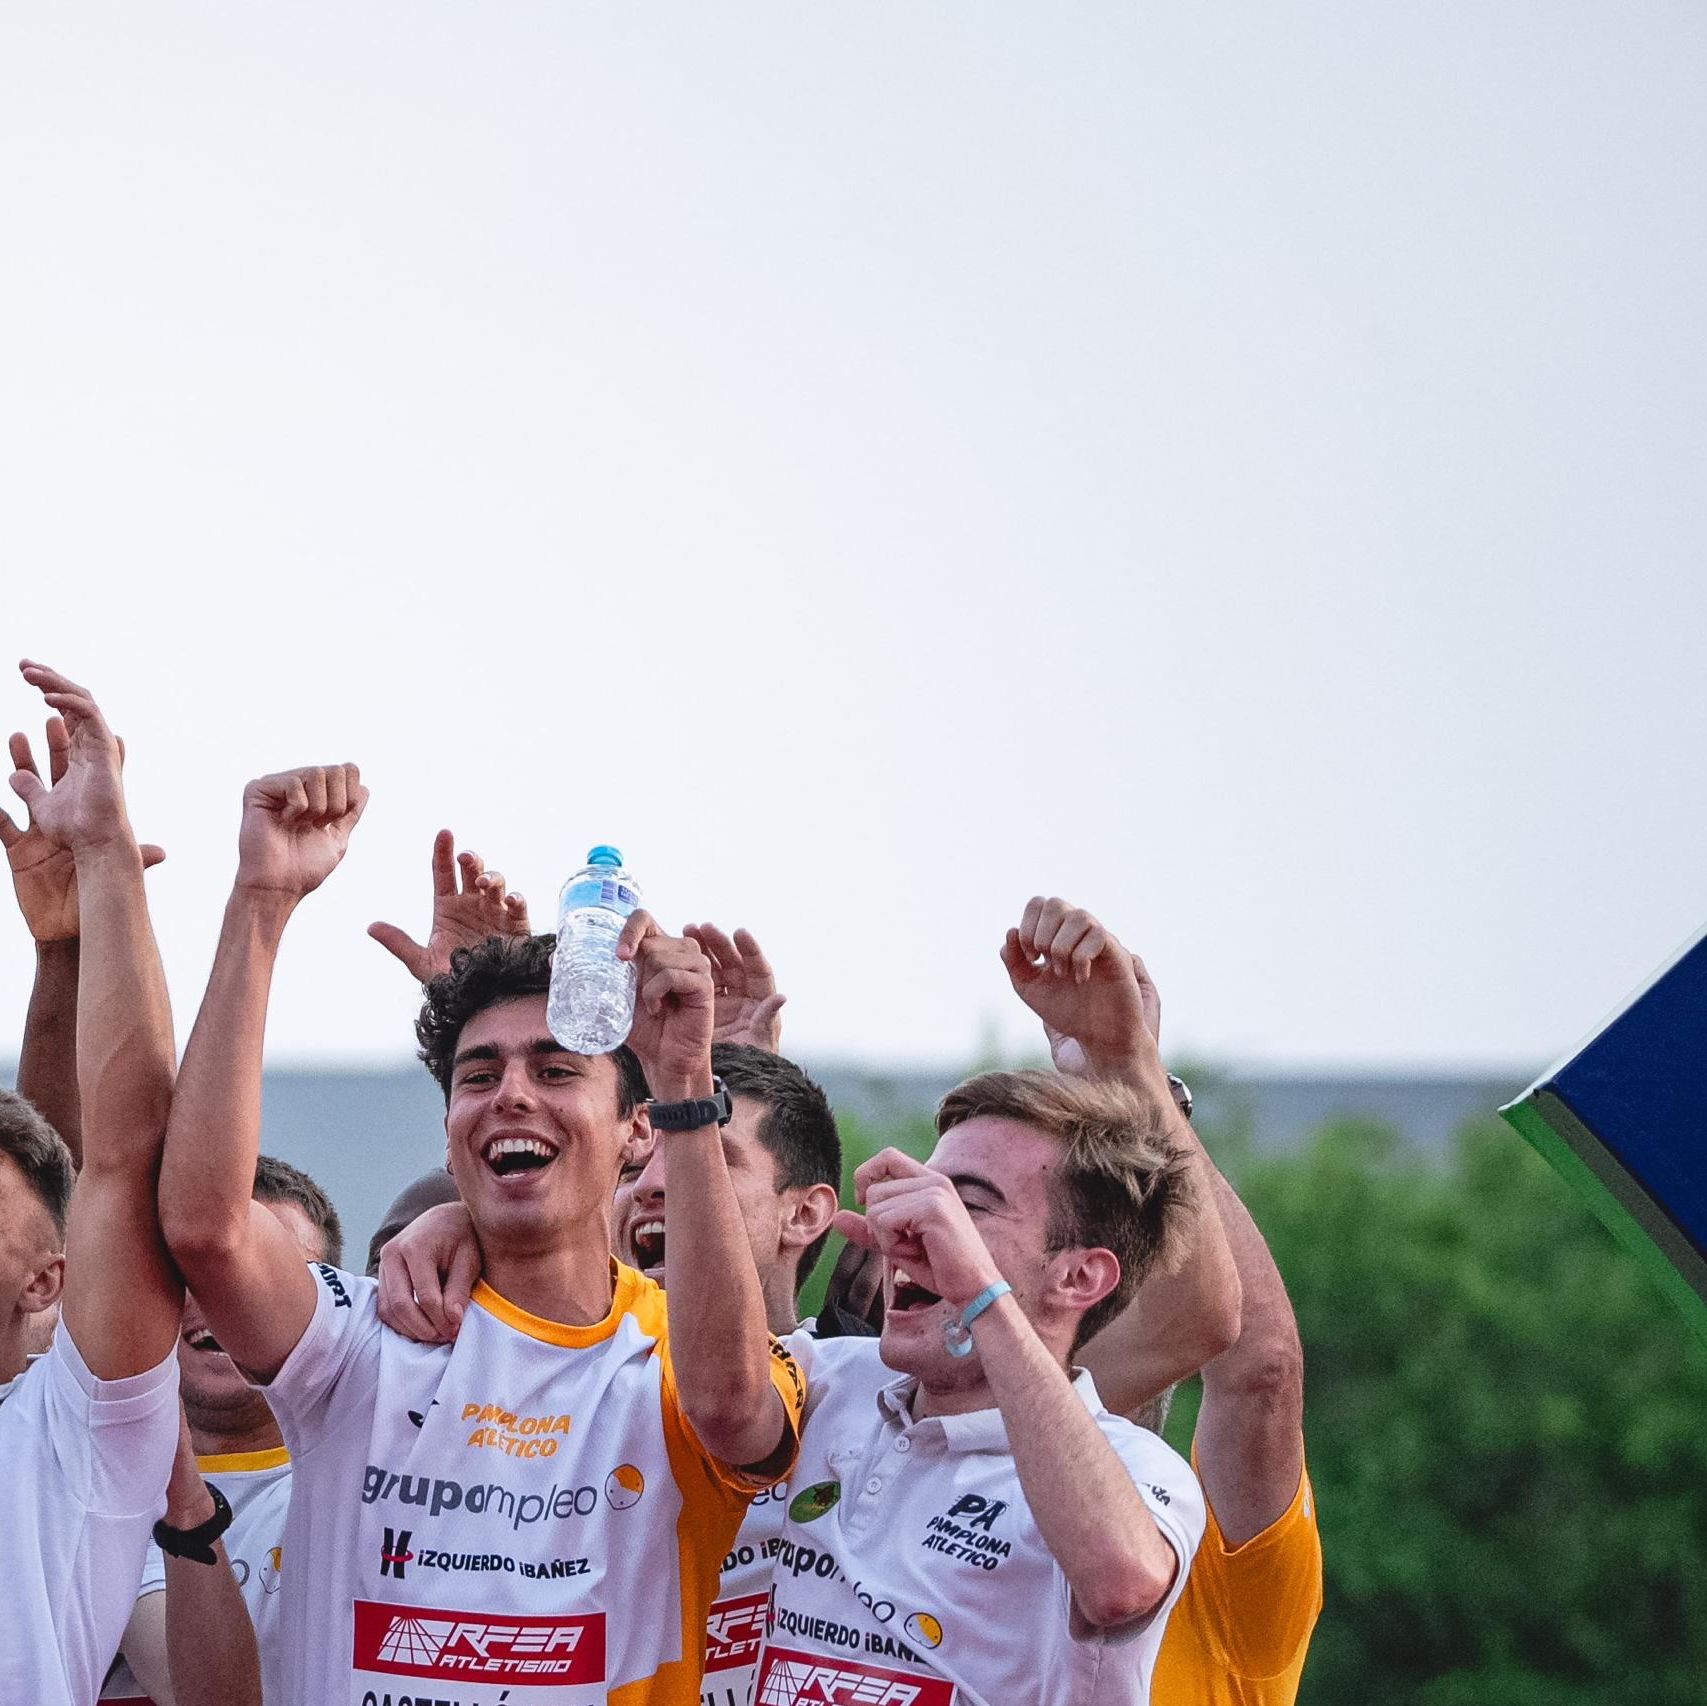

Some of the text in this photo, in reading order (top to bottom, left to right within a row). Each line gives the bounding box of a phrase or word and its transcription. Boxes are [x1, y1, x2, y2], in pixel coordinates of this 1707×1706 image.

[948, 1493, 1010, 1532] PA
[921, 1533, 999, 1571] ATLETICO
[926, 1516, 1012, 1558] PAMPLONA
[448, 1623, 584, 1654] RFEA
[865, 1632, 928, 1665] iBA
[439, 1654, 572, 1673] ATLETISMO
